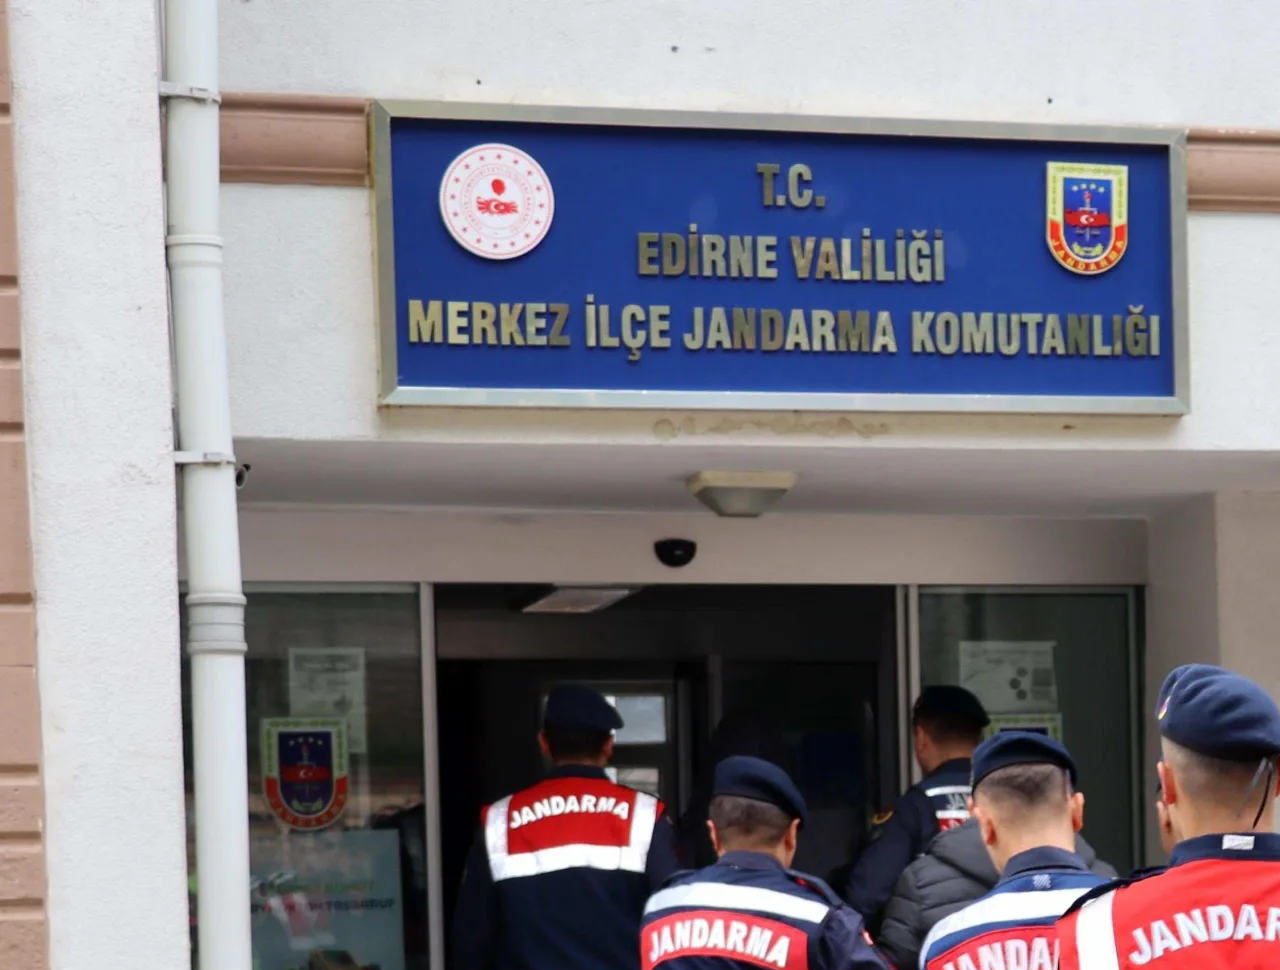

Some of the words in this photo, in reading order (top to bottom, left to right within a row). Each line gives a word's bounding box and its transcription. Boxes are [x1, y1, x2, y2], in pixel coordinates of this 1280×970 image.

[757, 163, 826, 208] T.C.
[638, 223, 778, 278] EDİRNE
[790, 227, 945, 282] VALİLİĞİ
[408, 299, 571, 347] MERKEZ
[585, 293, 672, 361] İLÇE
[683, 306, 898, 353] JANDARMA
[911, 304, 1161, 357] KOMUTANLIĞI
[510, 794, 630, 829] JANDARMA
[649, 917, 791, 969] JANDARMA
